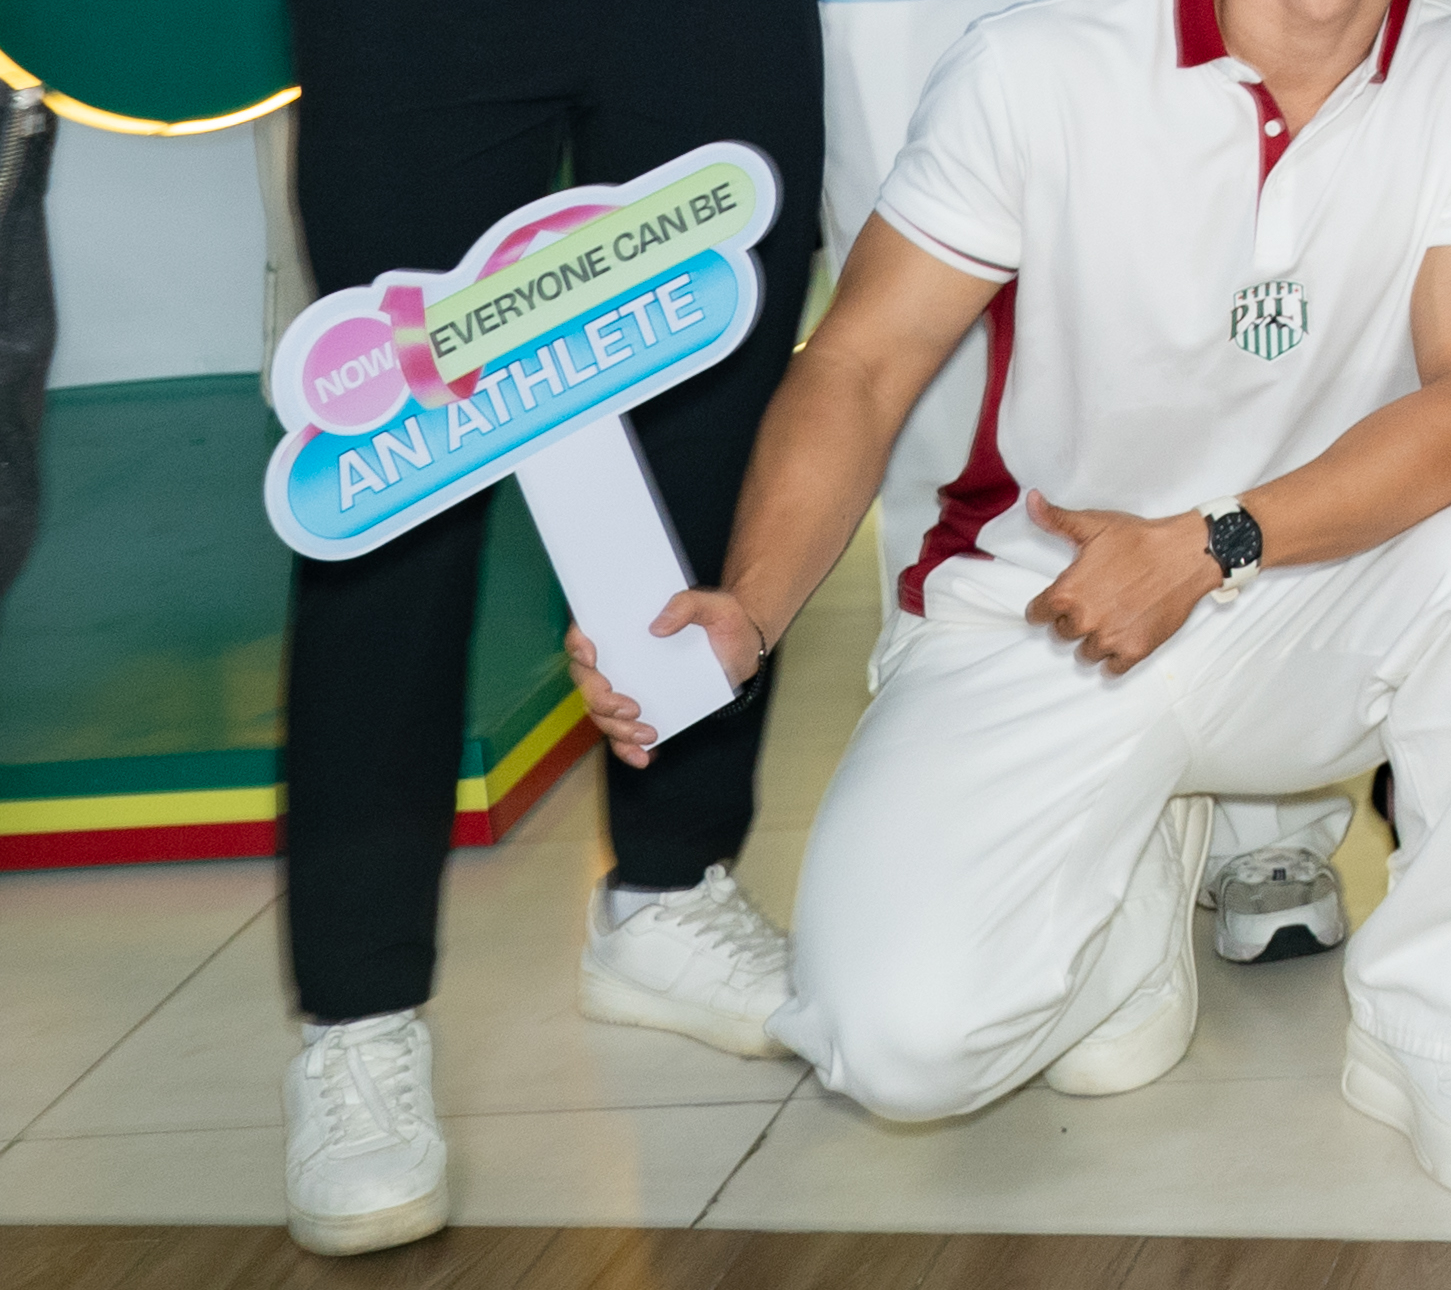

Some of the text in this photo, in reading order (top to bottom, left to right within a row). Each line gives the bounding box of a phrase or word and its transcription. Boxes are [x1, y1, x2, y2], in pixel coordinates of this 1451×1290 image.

[428, 181, 738, 360] EVERYONE CAN BE
[337, 272, 706, 513] AN ATHLETE
